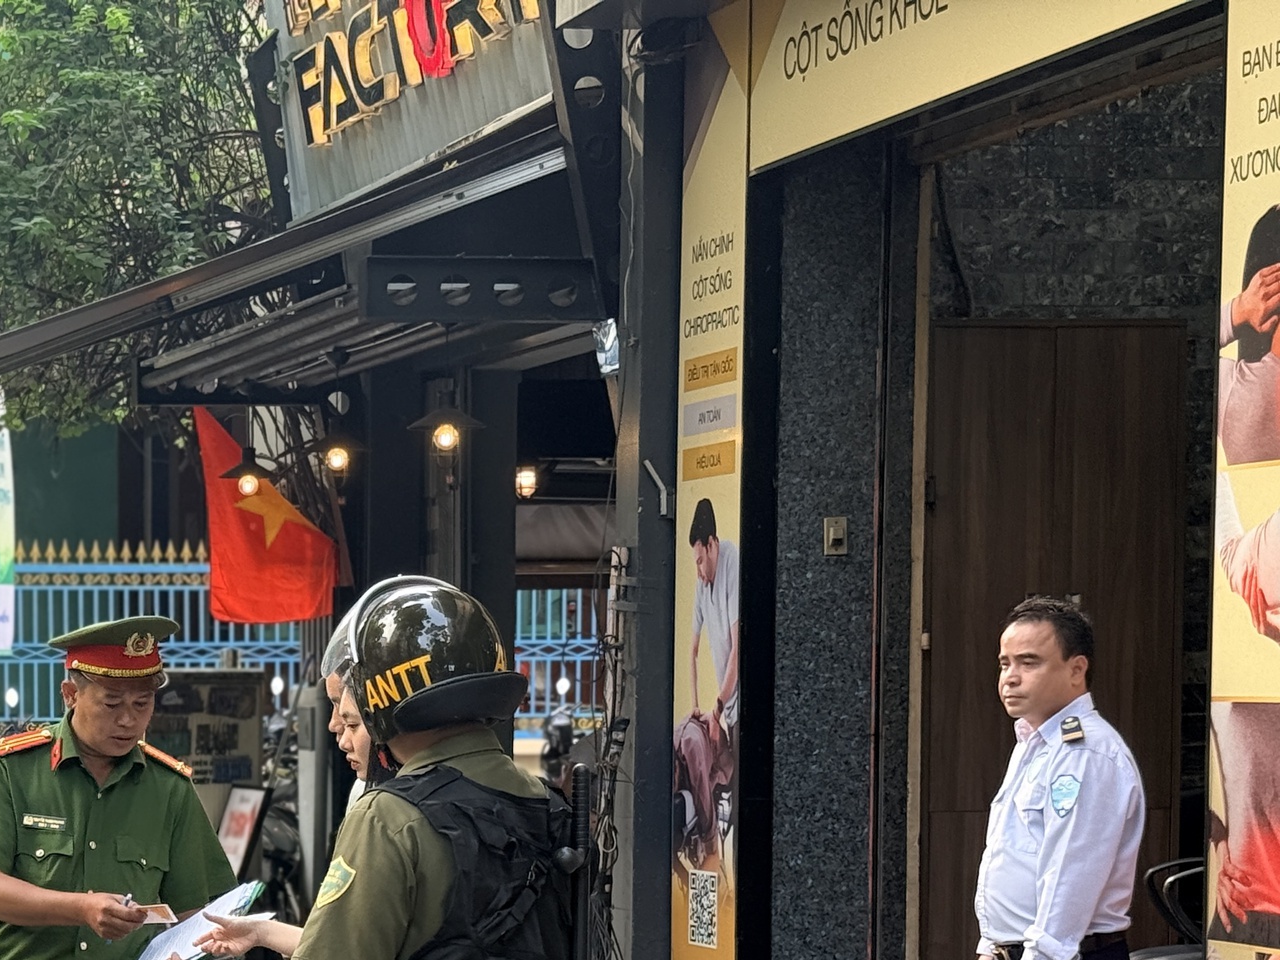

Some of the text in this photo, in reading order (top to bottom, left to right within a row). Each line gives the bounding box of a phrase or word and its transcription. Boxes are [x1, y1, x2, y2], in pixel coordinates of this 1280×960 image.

[784, 21, 822, 82] CỘT
[1242, 43, 1273, 78] BẠN
[692, 266, 732, 301] CỘT SỐNG
[684, 305, 740, 338] CHIROPRACTIC
[365, 654, 432, 713] ANTT
